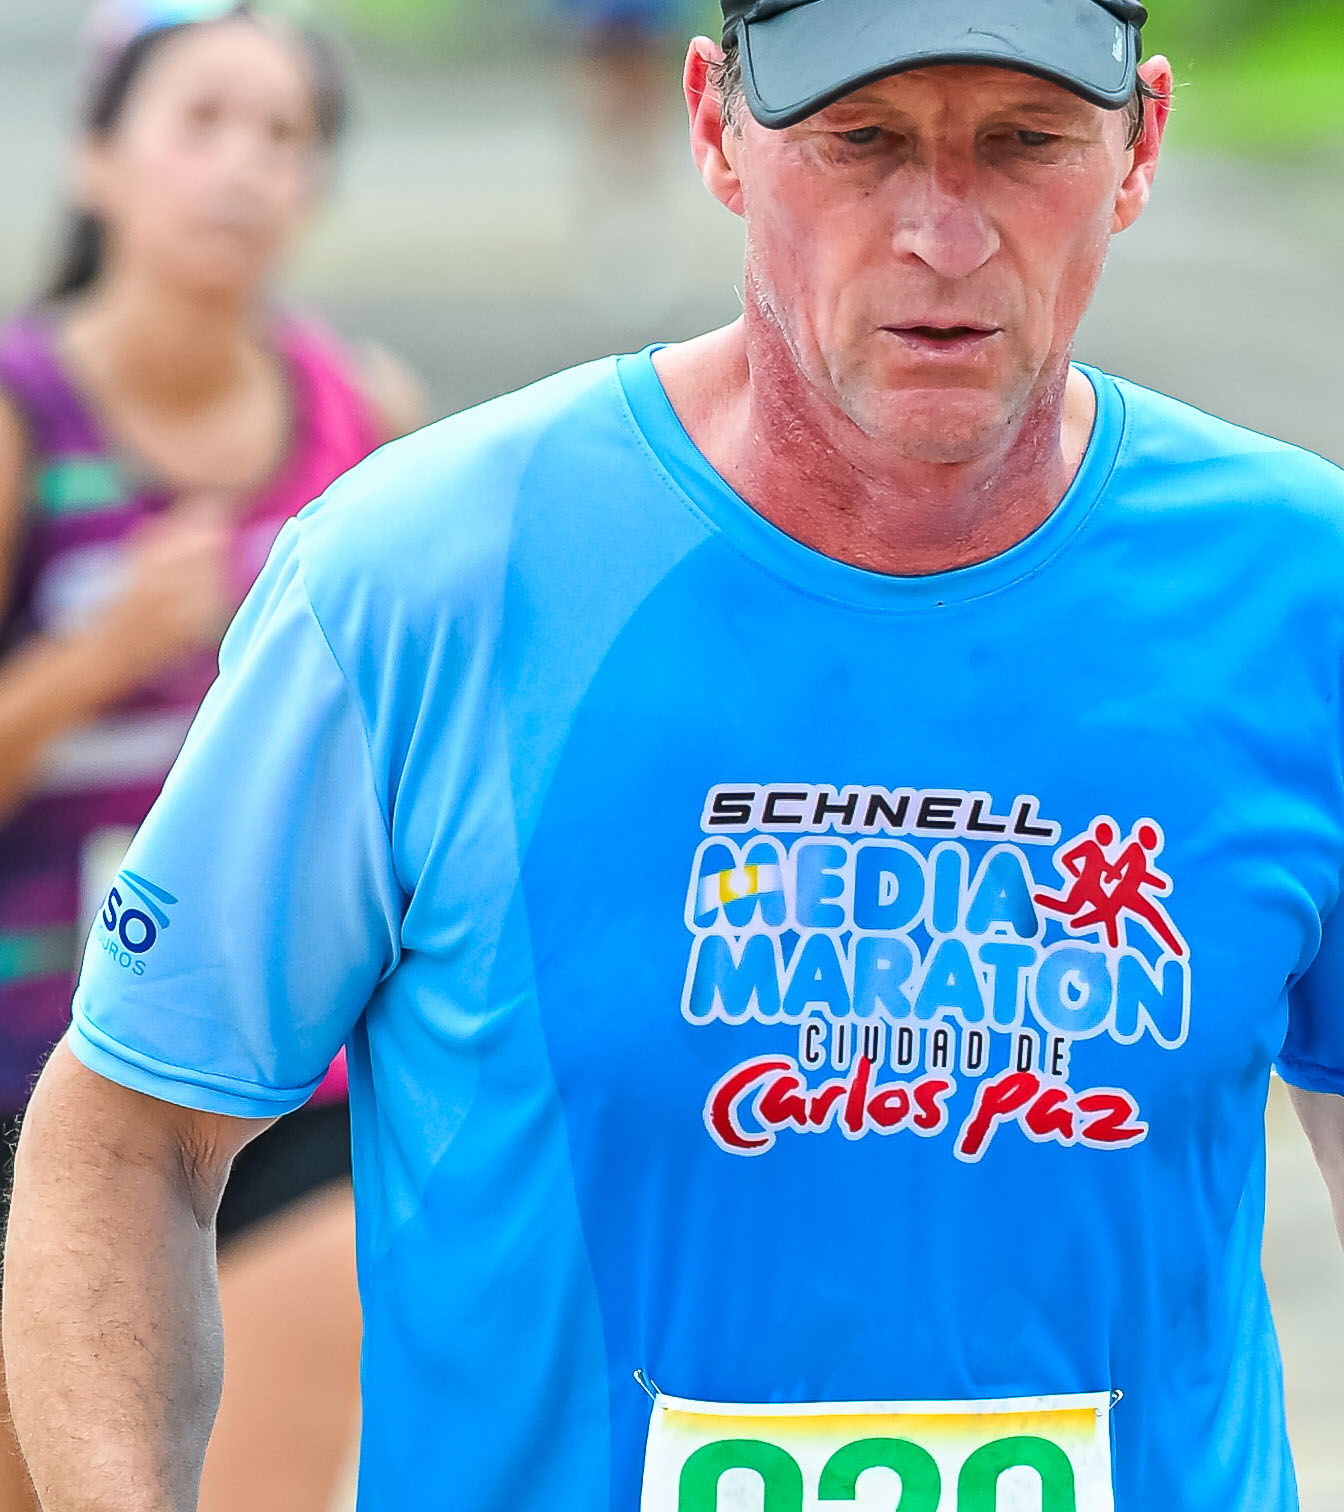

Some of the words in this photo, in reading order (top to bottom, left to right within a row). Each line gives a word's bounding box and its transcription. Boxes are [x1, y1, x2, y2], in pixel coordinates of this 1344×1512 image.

[709, 790, 1054, 838] SCHNELL
[688, 838, 1042, 939] MEDIA
[684, 933, 1186, 1046] MARATON
[806, 1024, 983, 1070] CIUDAD
[1016, 1034, 1065, 1076] DE
[710, 1055, 949, 1148] Carlos
[960, 1072, 1149, 1155] Paz
